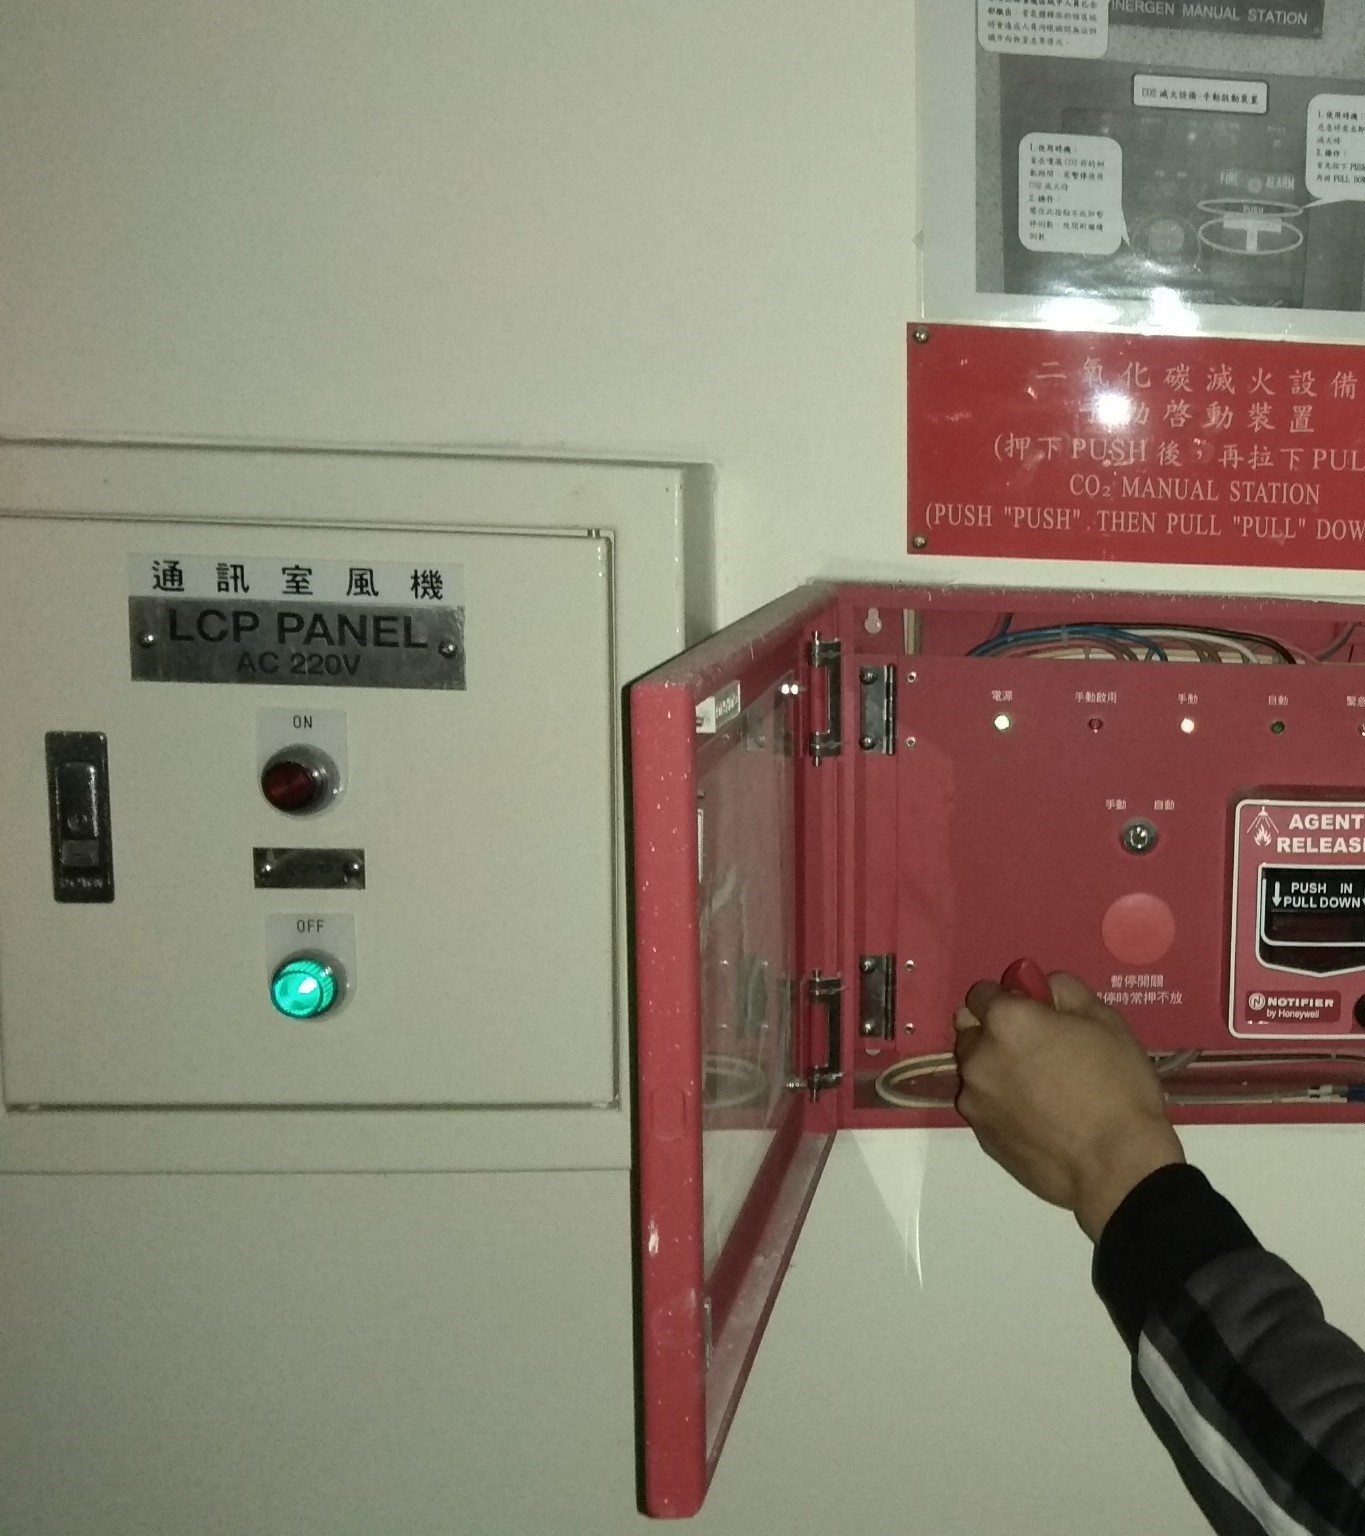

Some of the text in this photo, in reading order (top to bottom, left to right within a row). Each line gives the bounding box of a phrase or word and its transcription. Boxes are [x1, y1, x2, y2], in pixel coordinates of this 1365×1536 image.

[1182, 5, 1240, 22] MANUAL
[1247, 9, 1308, 25] STATION
[1035, 356, 1359, 400] 二氧化碳滅火設備
[1121, 476, 1219, 502] MANUAL
[1229, 480, 1321, 505] STATION
[925, 502, 993, 530] (PUSH
[1097, 510, 1157, 534] THEN
[1167, 513, 1222, 538] PULL
[1233, 514, 1306, 540] "PULL"
[152, 559, 443, 601] 通訊室風機
[168, 608, 429, 649] LCP PANEL
[235, 651, 362, 677] AC 220V
[991, 690, 1013, 702] 電源
[1178, 693, 1199, 705] 手動
[1268, 694, 1289, 706] 自動
[293, 714, 313, 729] ON
[1105, 798, 1127, 811] 手動
[1153, 799, 1175, 811] 自動
[1288, 813, 1365, 830] AGENT
[1291, 882, 1353, 895] PUSH IN
[1283, 896, 1361, 909] PULL DOWN
[296, 919, 325, 934] OFF
[1267, 996, 1334, 1008] NOTIFIER
[1266, 1008, 1320, 1020] by Honeywell
